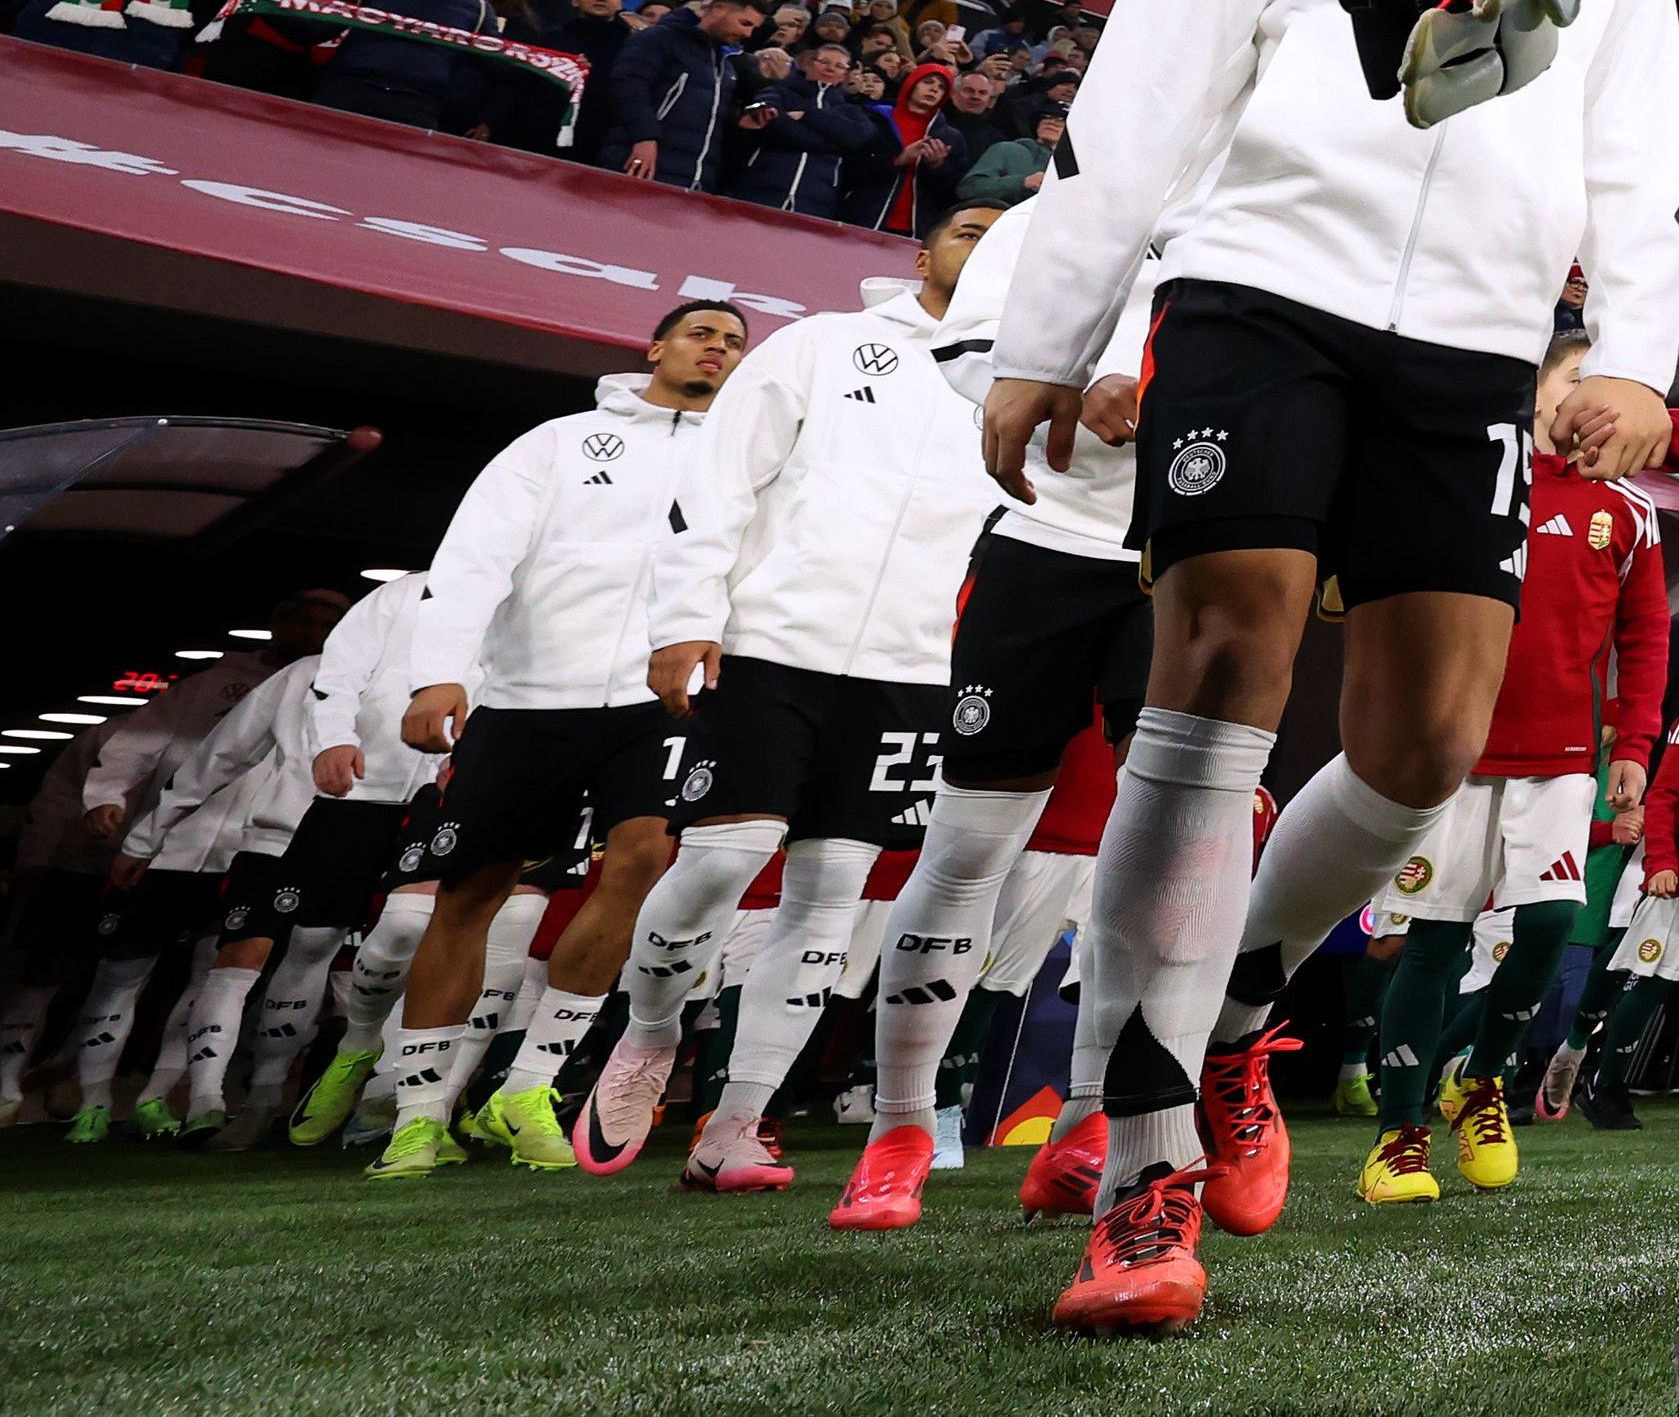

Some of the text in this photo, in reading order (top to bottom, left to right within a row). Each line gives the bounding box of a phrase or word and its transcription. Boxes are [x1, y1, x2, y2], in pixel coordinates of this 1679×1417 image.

[662, 735, 687, 780] 1
[868, 731, 944, 792] 23
[648, 931, 713, 951] DFB
[896, 933, 973, 956] DFB
[402, 1039, 451, 1057] DFB
